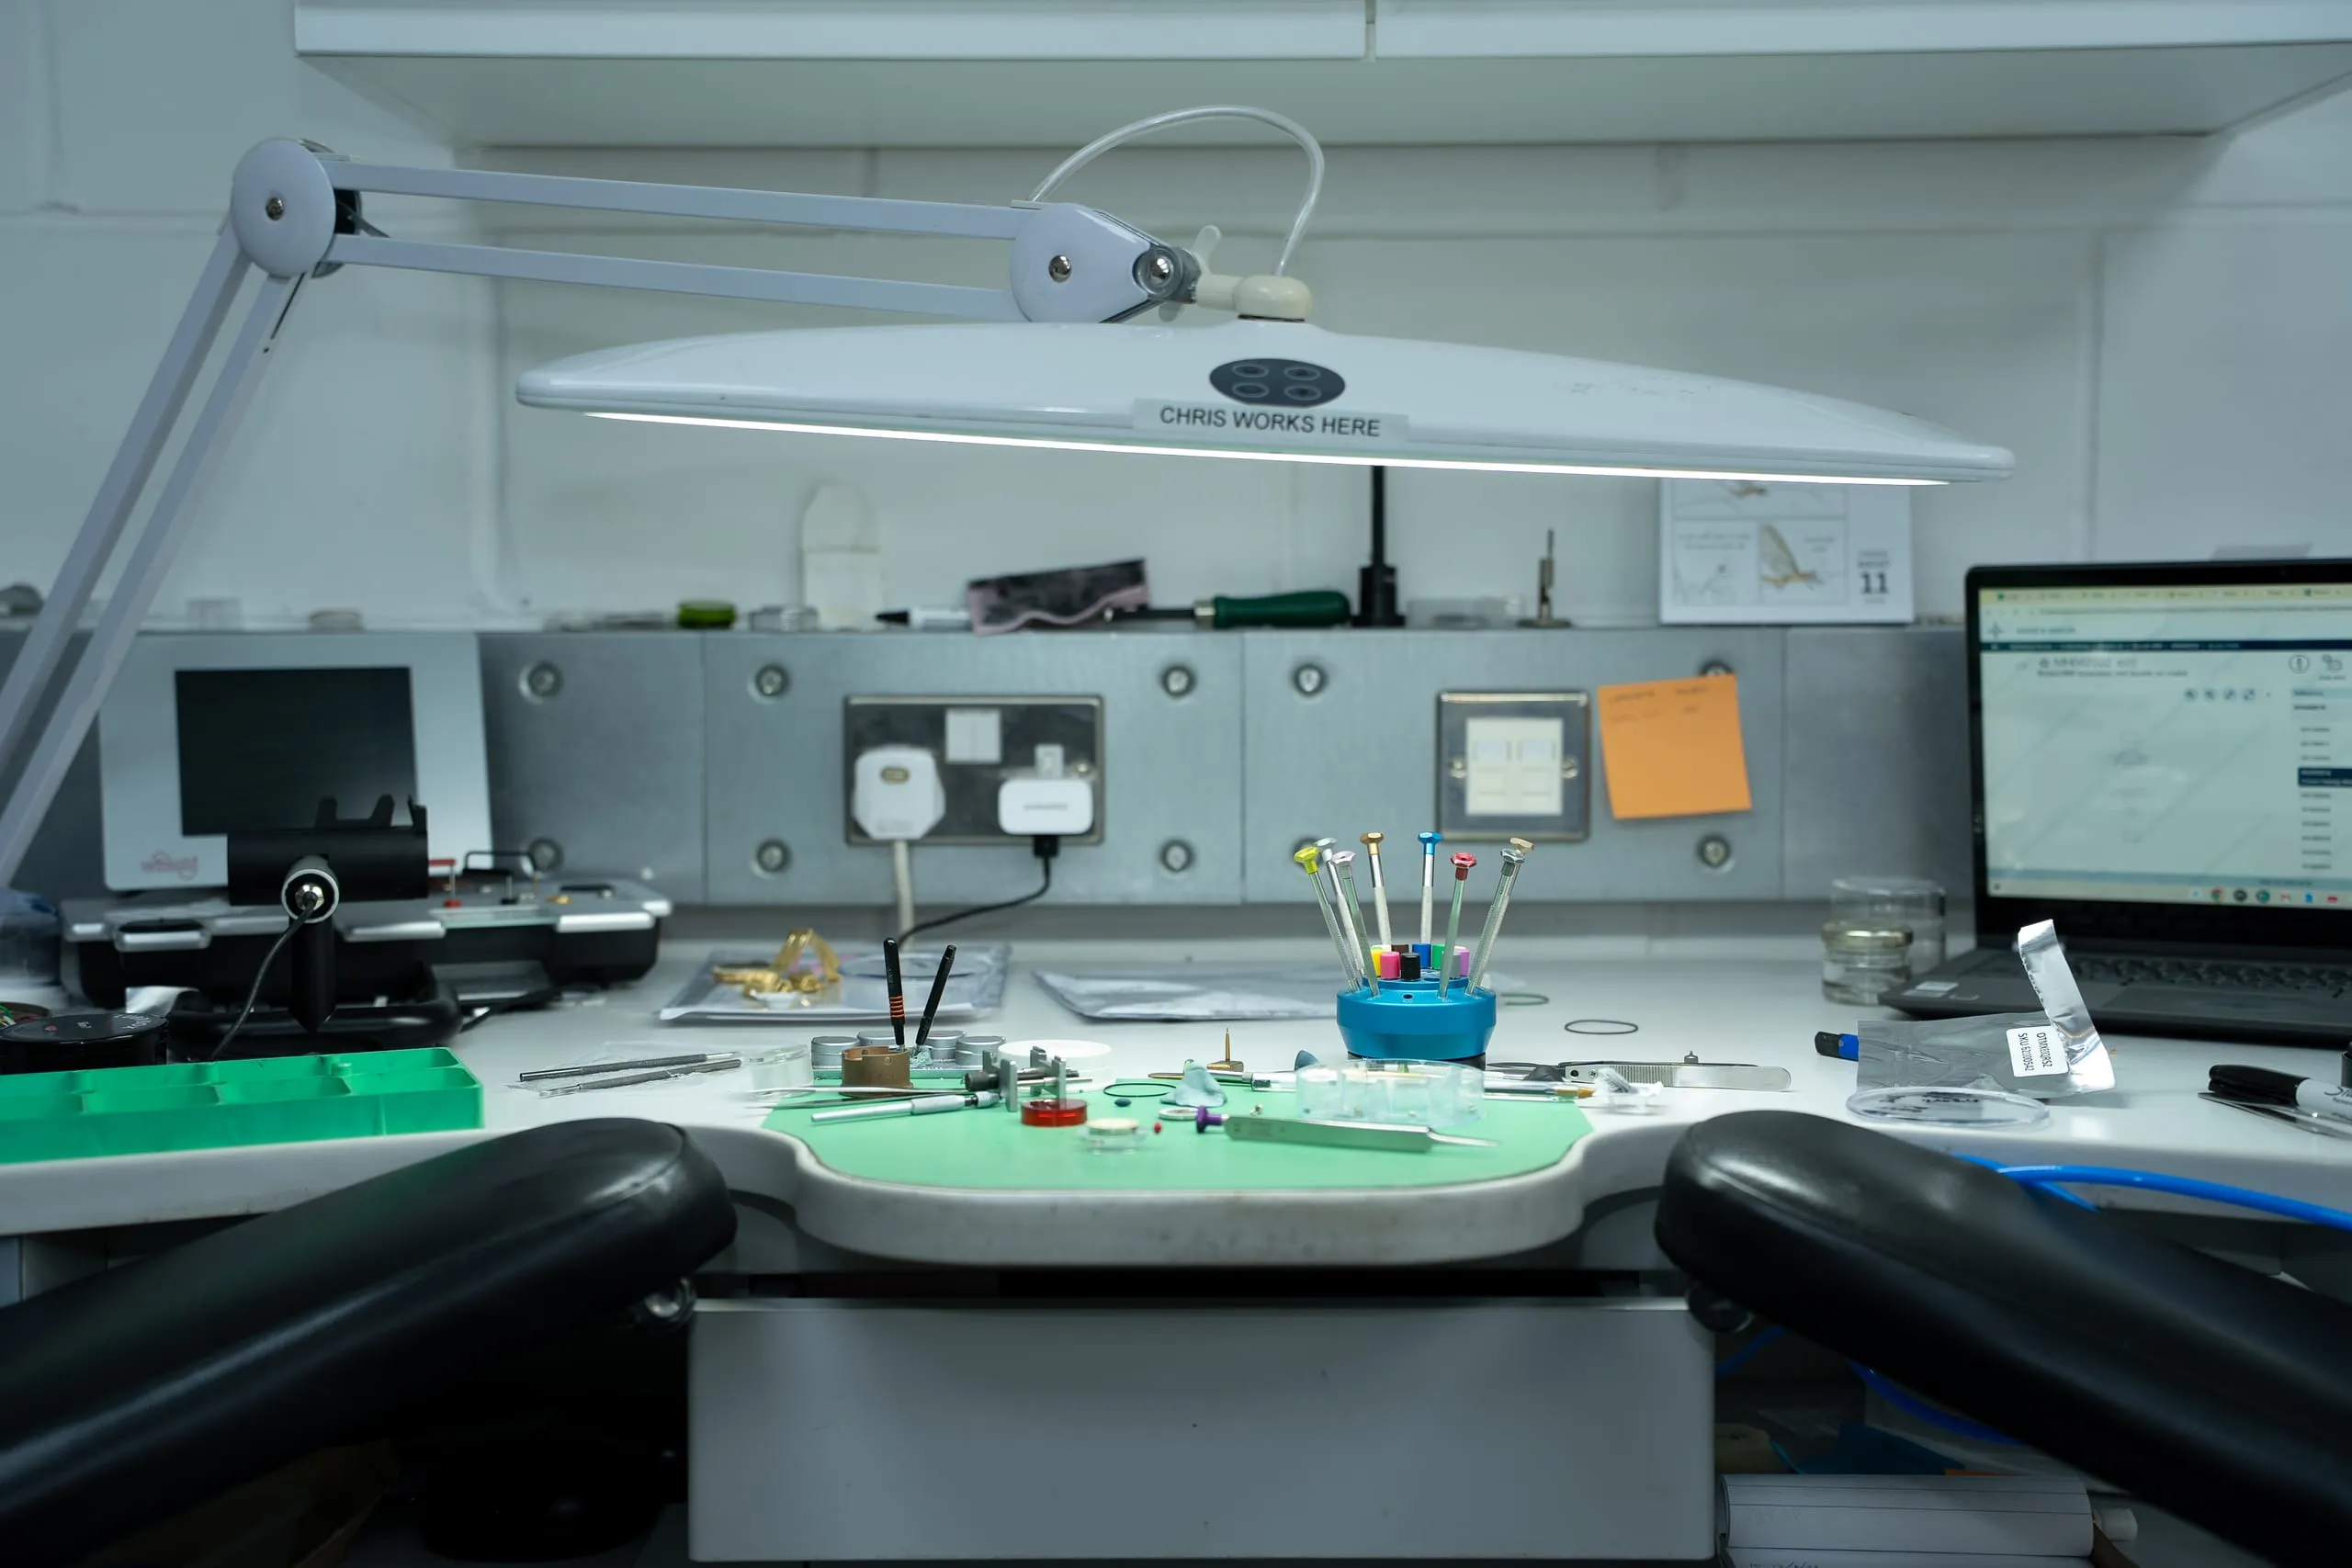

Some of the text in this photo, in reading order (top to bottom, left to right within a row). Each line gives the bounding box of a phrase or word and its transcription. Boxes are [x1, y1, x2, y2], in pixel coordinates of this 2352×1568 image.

[1159, 405, 1381, 437] CHRIS WORKS HERE
[1860, 570, 1889, 595] 11
[2018, 1032, 2030, 1045] SKU
